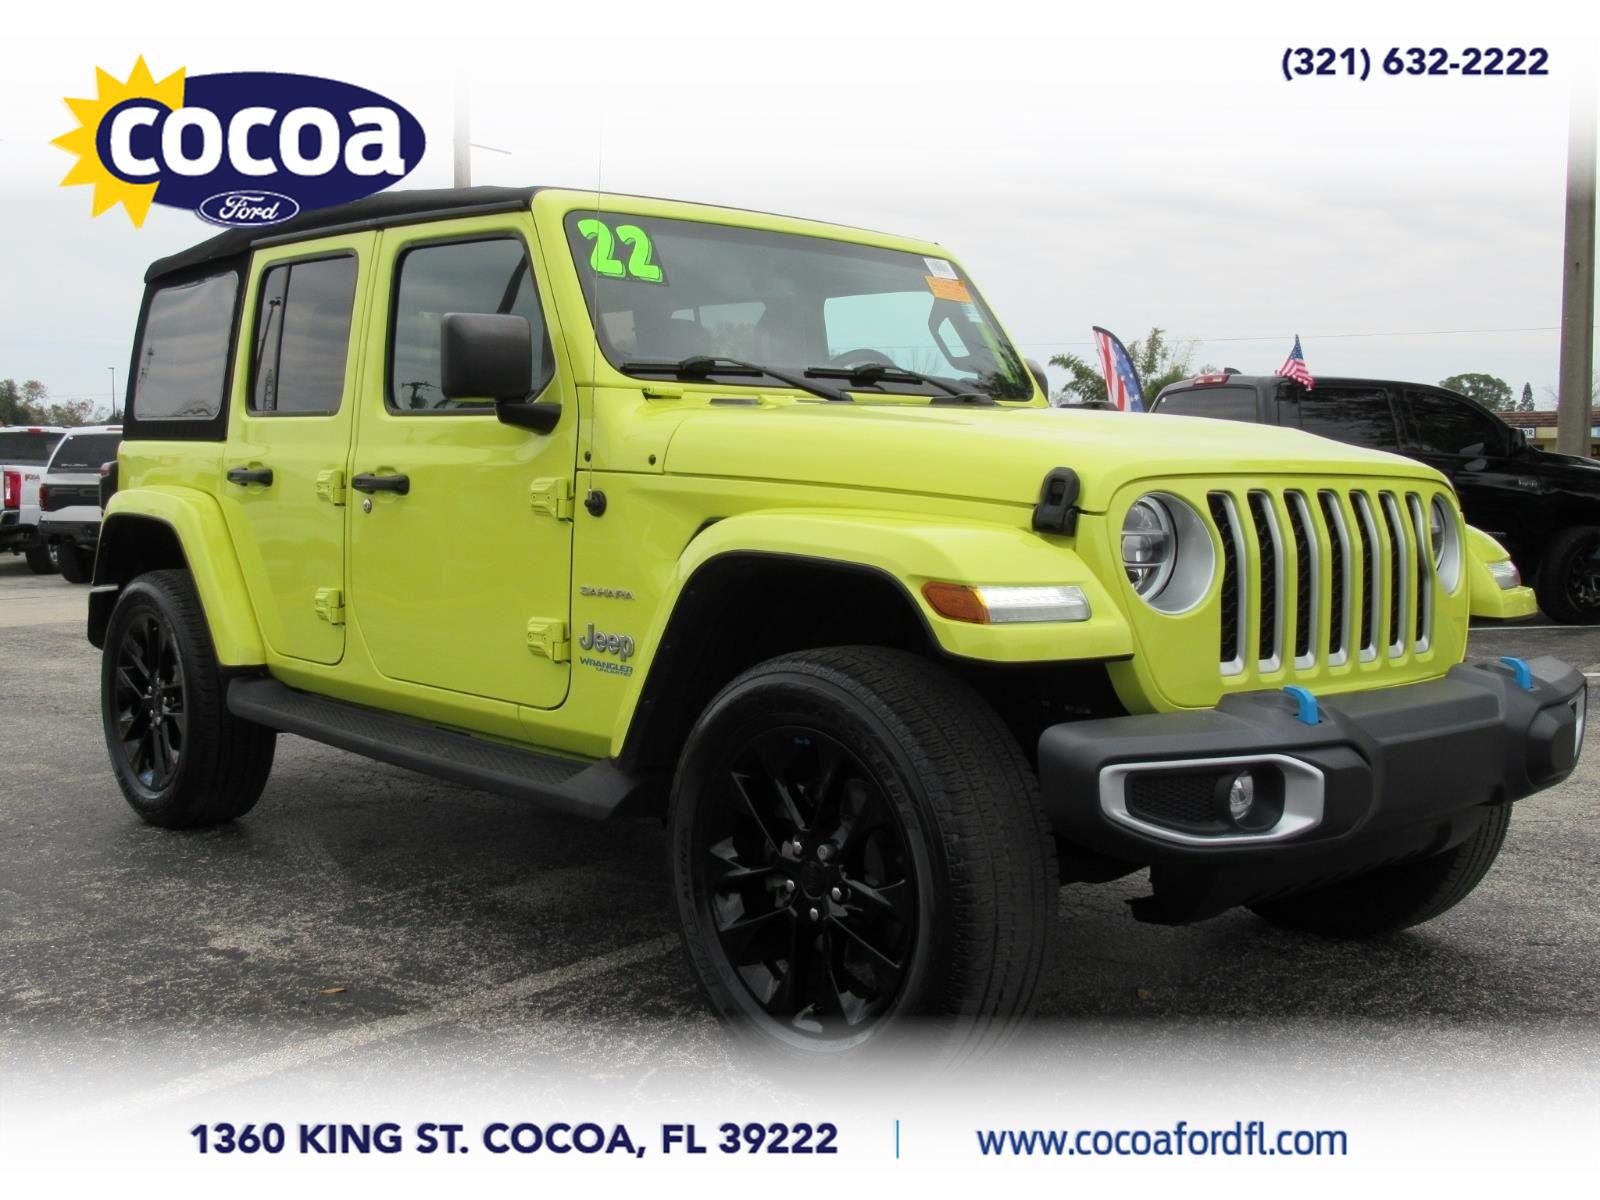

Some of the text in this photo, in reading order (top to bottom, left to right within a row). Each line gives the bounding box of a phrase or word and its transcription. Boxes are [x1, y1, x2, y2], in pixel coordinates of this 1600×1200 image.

[577, 218, 663, 283] 22
[579, 586, 635, 601] SAHARA
[578, 623, 635, 663] Jeep
[579, 656, 634, 674] WRANGLER
